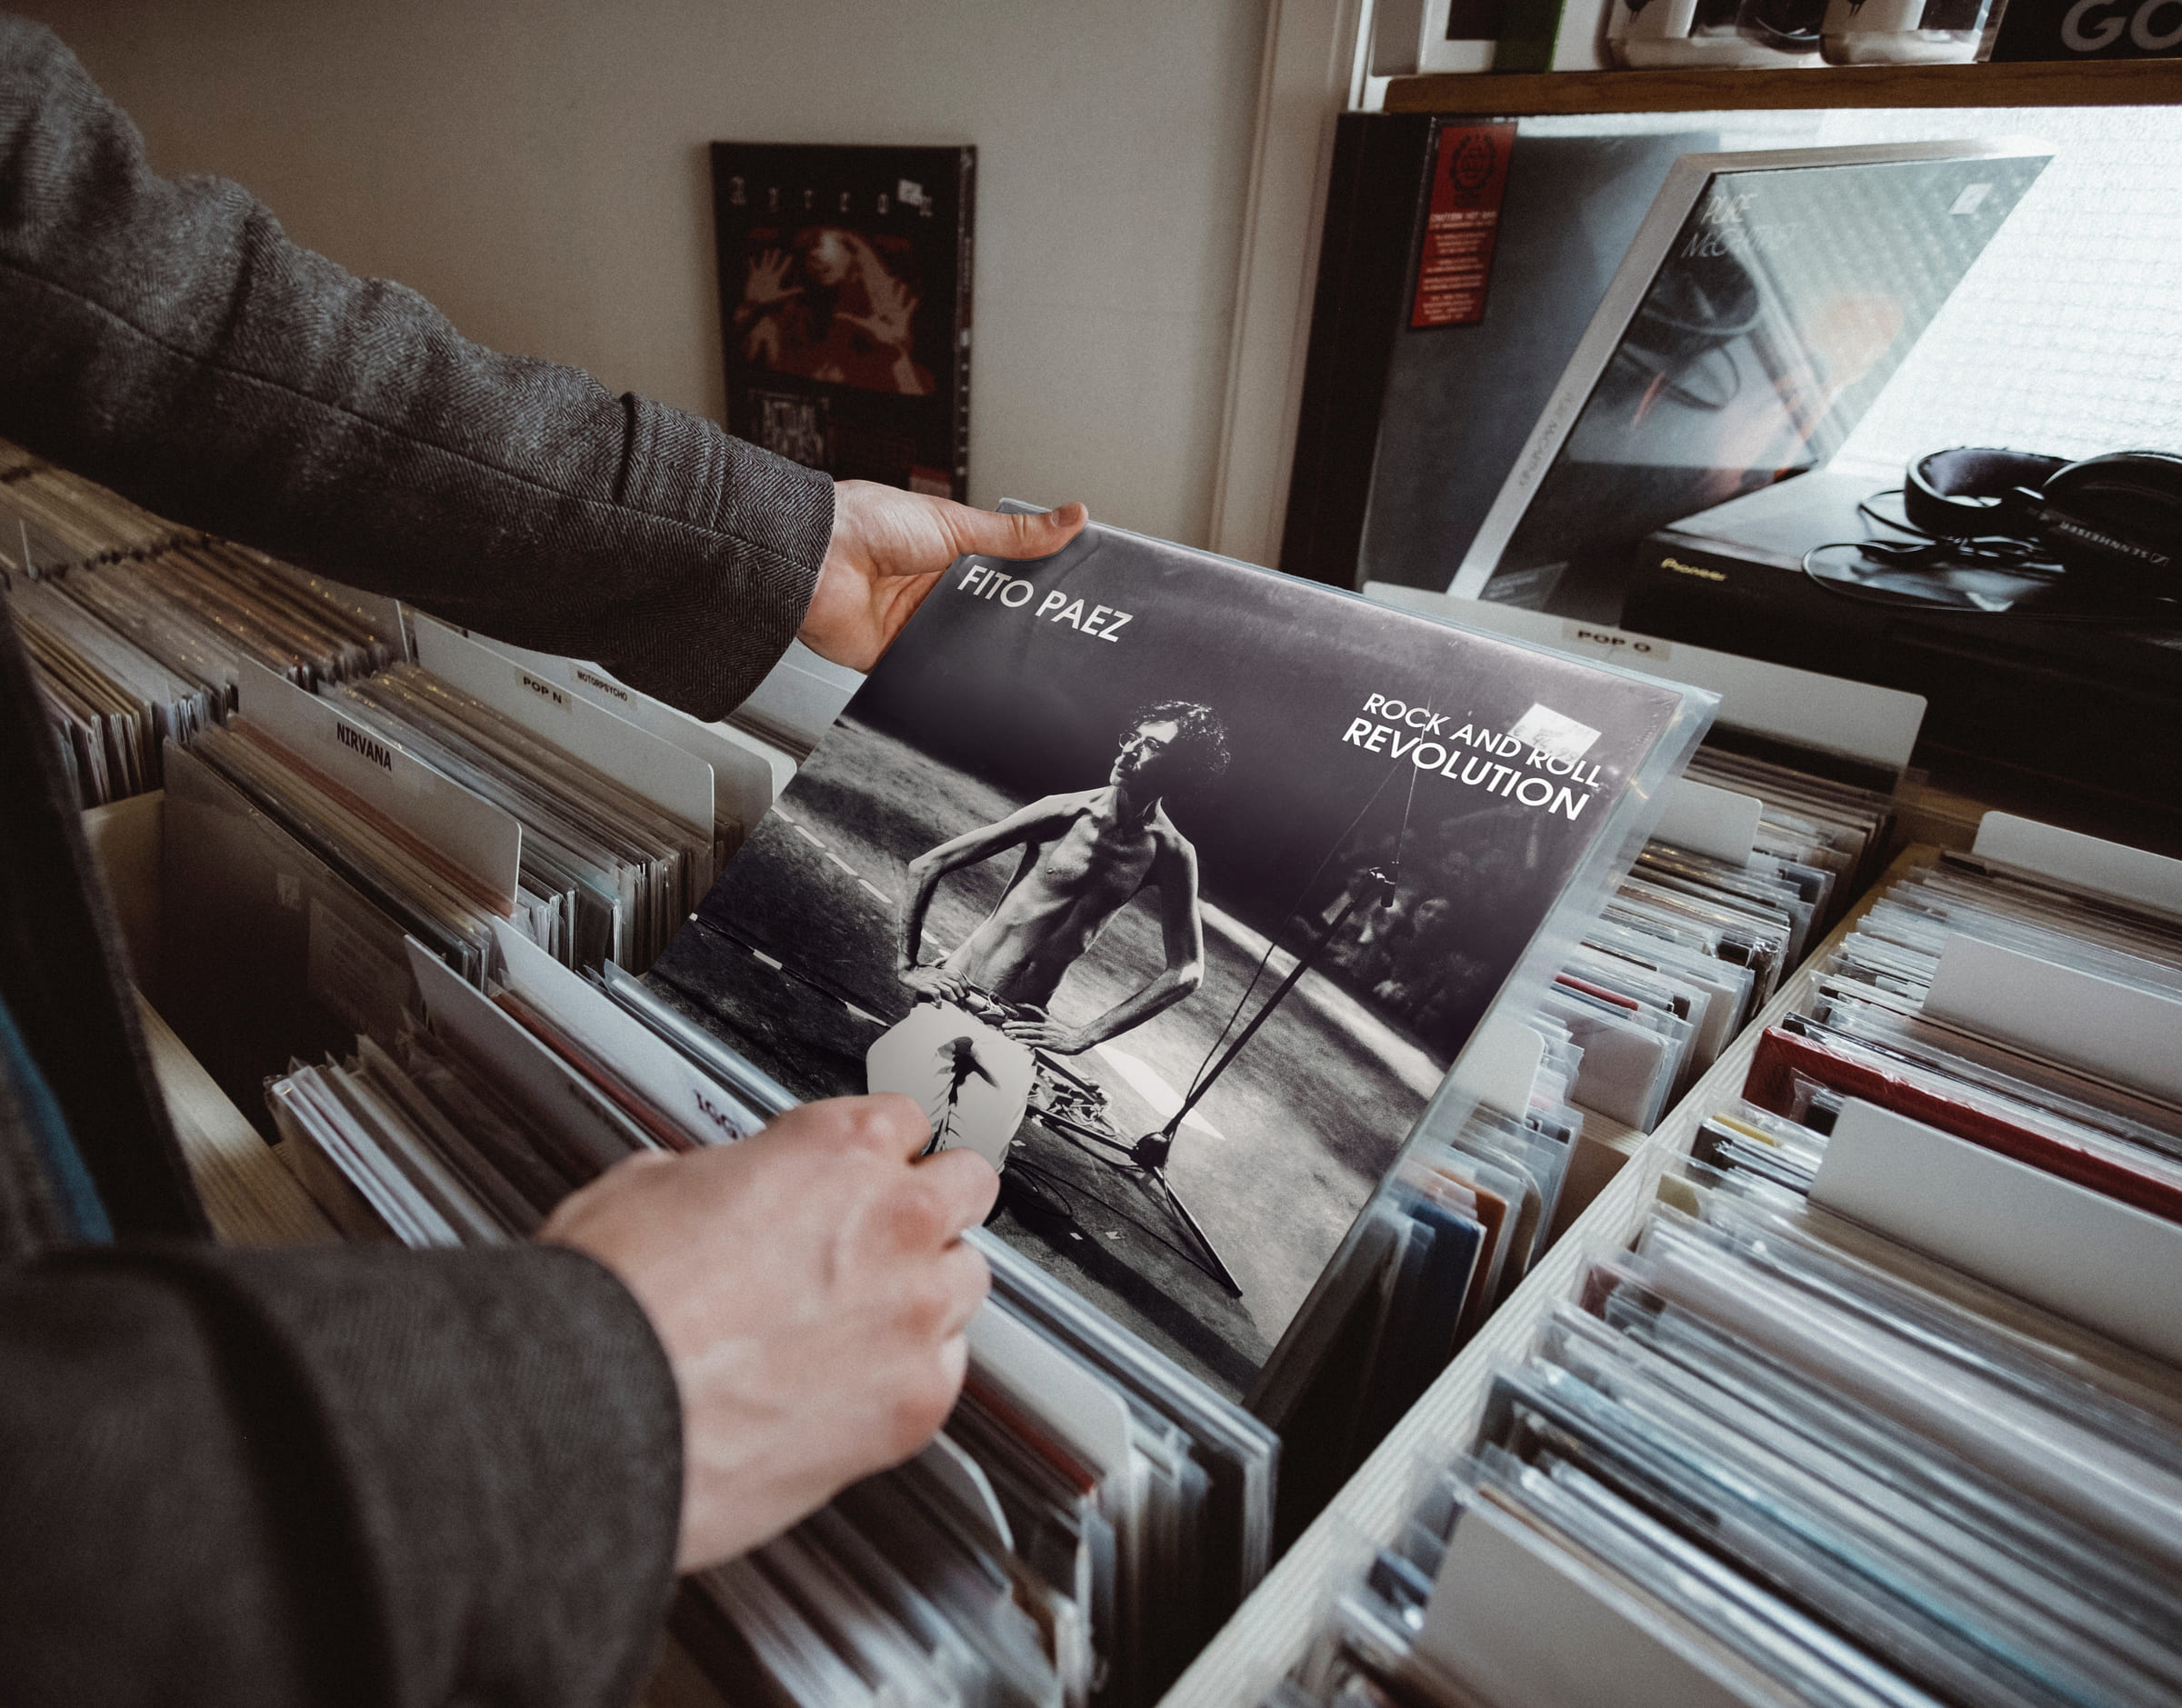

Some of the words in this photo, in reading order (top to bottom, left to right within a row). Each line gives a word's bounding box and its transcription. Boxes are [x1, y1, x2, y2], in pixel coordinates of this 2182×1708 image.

[2058, 521, 2149, 559] SENNHEISER
[1660, 557, 1728, 582] Pioneer
[957, 564, 1035, 608] FITO
[1035, 590, 1134, 643] PAEZ
[1577, 630, 1626, 646] POP
[1634, 642, 1651, 653] O
[523, 675, 549, 695] POP
[553, 692, 562, 704] N
[576, 670, 628, 703] MOTORPSYCHO
[336, 721, 392, 772] NIRVANA
[1363, 693, 1451, 735] ROCK
[1449, 724, 1522, 758] AND
[1526, 747, 1602, 788] ROLL
[1342, 717, 1590, 821] REVOLUTION
